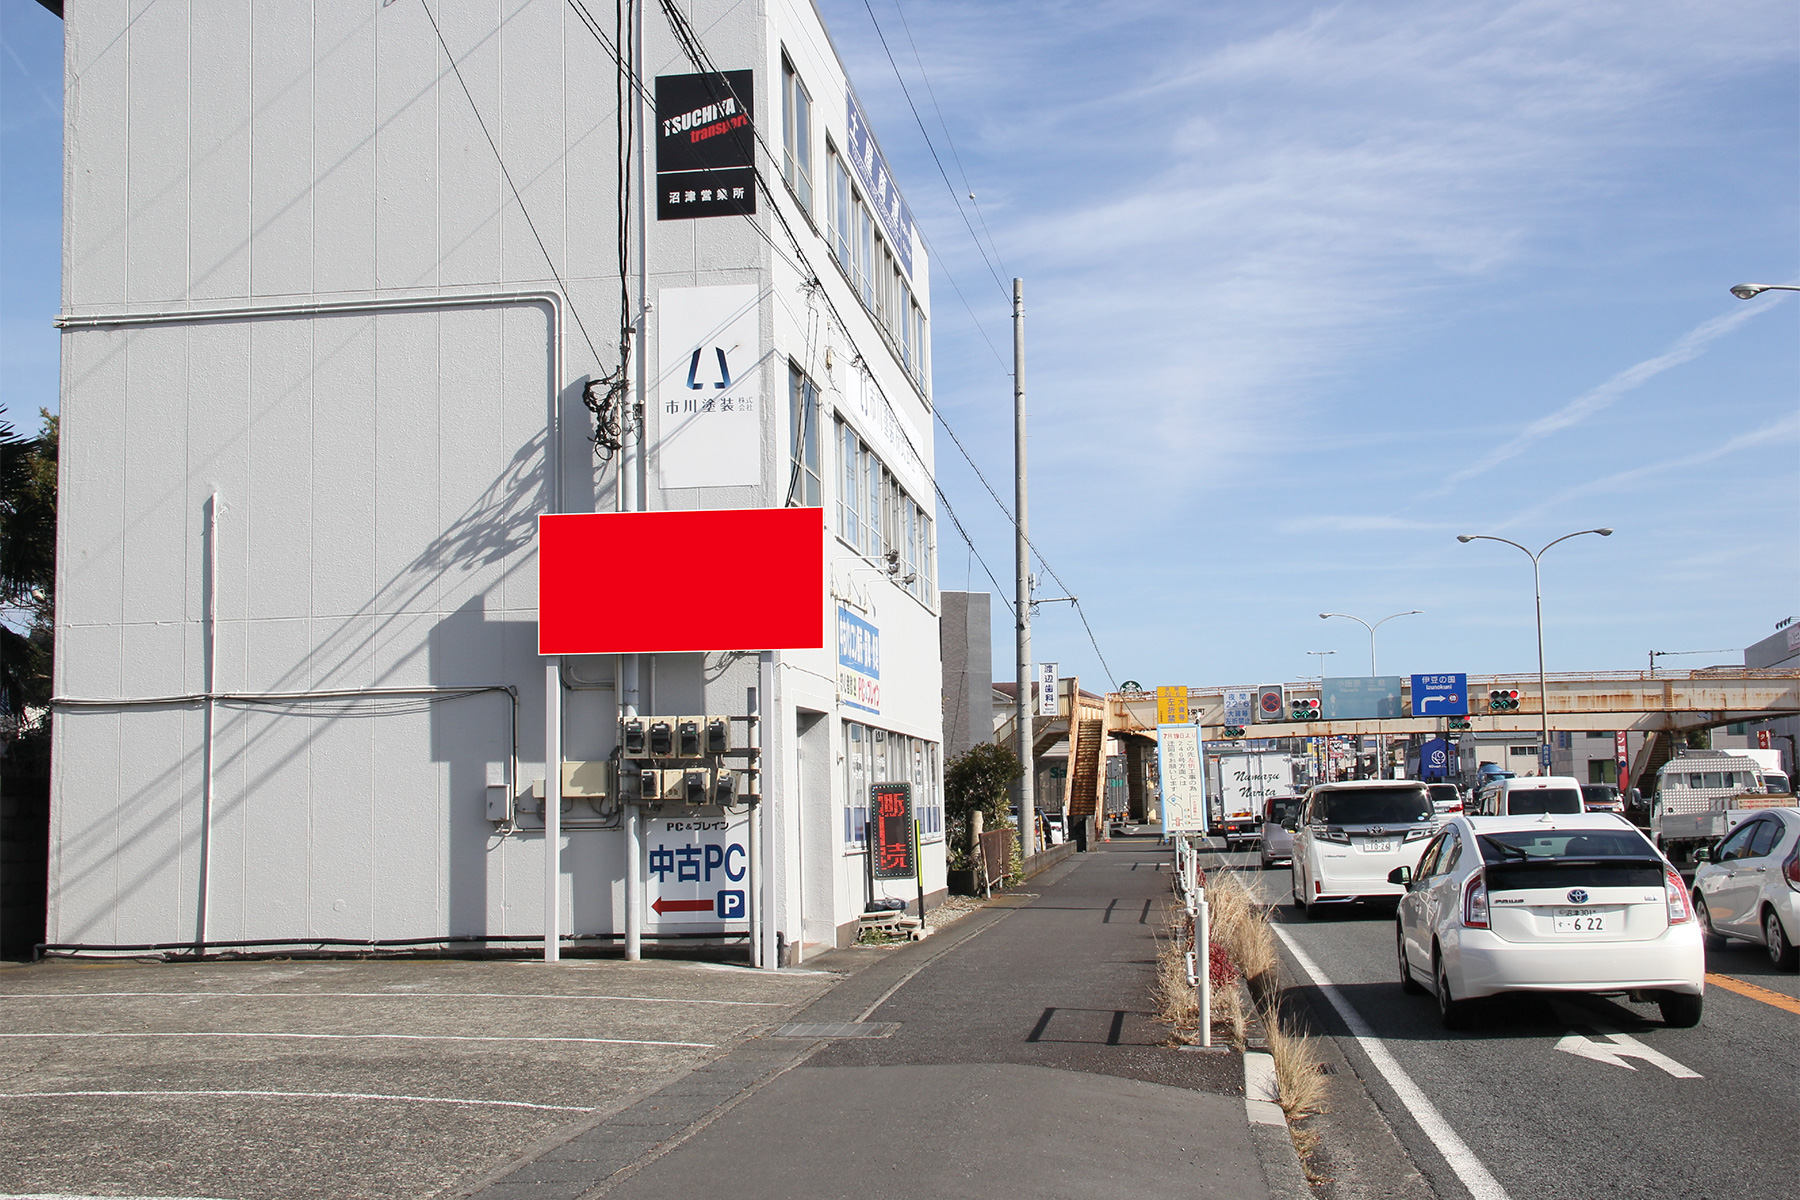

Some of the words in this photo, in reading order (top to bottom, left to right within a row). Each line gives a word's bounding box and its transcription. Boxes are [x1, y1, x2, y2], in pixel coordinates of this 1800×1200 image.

[663, 97, 736, 137] TSUCHIYA
[690, 112, 748, 143] transport
[669, 187, 744, 204] 沼津営業所
[665, 398, 735, 415] 市川塗装
[1422, 675, 1456, 685] 伊豆の国
[1233, 771, 1280, 783] Numazu
[1239, 787, 1276, 798] Narita
[650, 843, 746, 882] 中古PC
[724, 895, 740, 914] P
